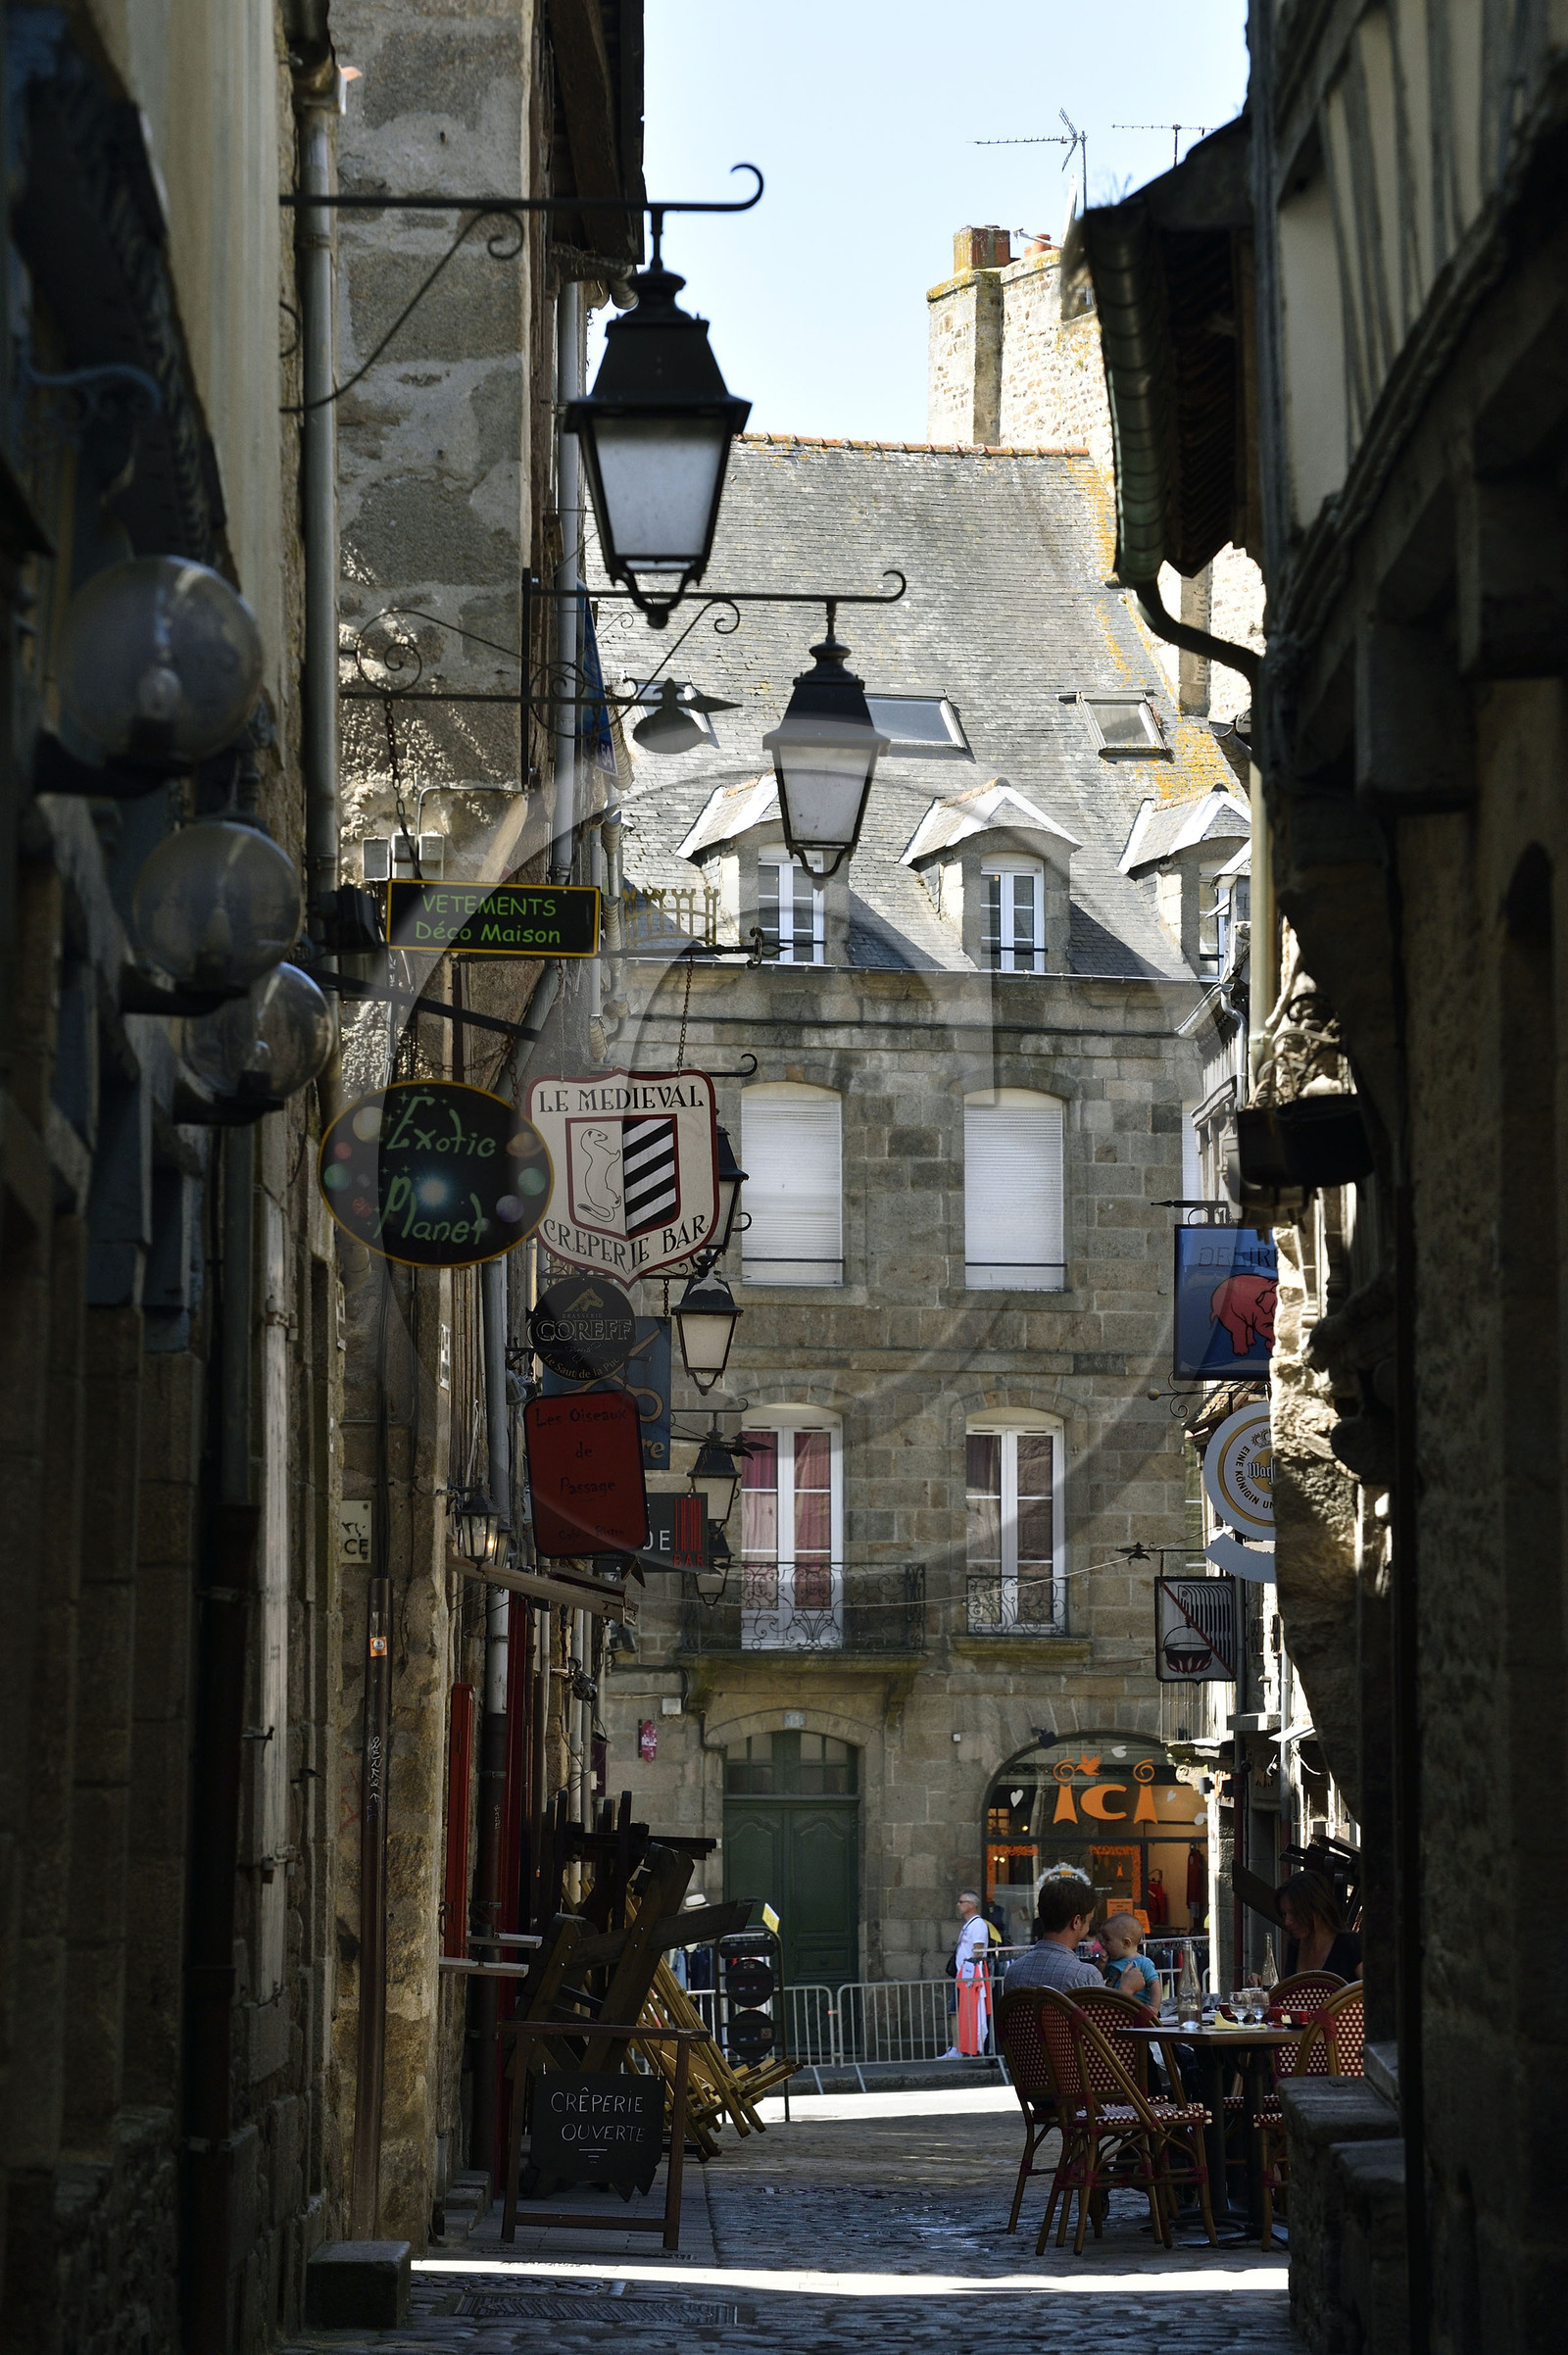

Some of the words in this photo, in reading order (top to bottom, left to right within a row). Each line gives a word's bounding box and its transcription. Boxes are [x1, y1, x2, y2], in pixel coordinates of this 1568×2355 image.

[421, 894, 558, 917] VETEMENTS
[416, 920, 471, 941] Déco
[480, 922, 562, 944] Maison
[539, 1090, 568, 1112] LE
[578, 1085, 705, 1111] MEDIEVAL
[386, 1095, 497, 1158] Exotic
[372, 1175, 485, 1246] Planet
[543, 1218, 650, 1274] CREPERIE
[662, 1214, 710, 1254] BAR
[535, 1318, 632, 1342] COREFF
[544, 1353, 556, 1365] Le
[555, 1362, 576, 1380] Saut
[592, 1367, 604, 1377] la
[535, 1408, 563, 1427] Les
[569, 1407, 627, 1422] Oiseaux
[574, 1441, 593, 1460] de
[1235, 1446, 1250, 1467] EINE
[560, 1476, 616, 1496] Passage
[1235, 1470, 1260, 1505] KÖNIGIN
[672, 1553, 705, 1568] BAR
[550, 2086, 644, 2113] CRÊPERIE
[561, 2123, 646, 2143] OUVERTE
